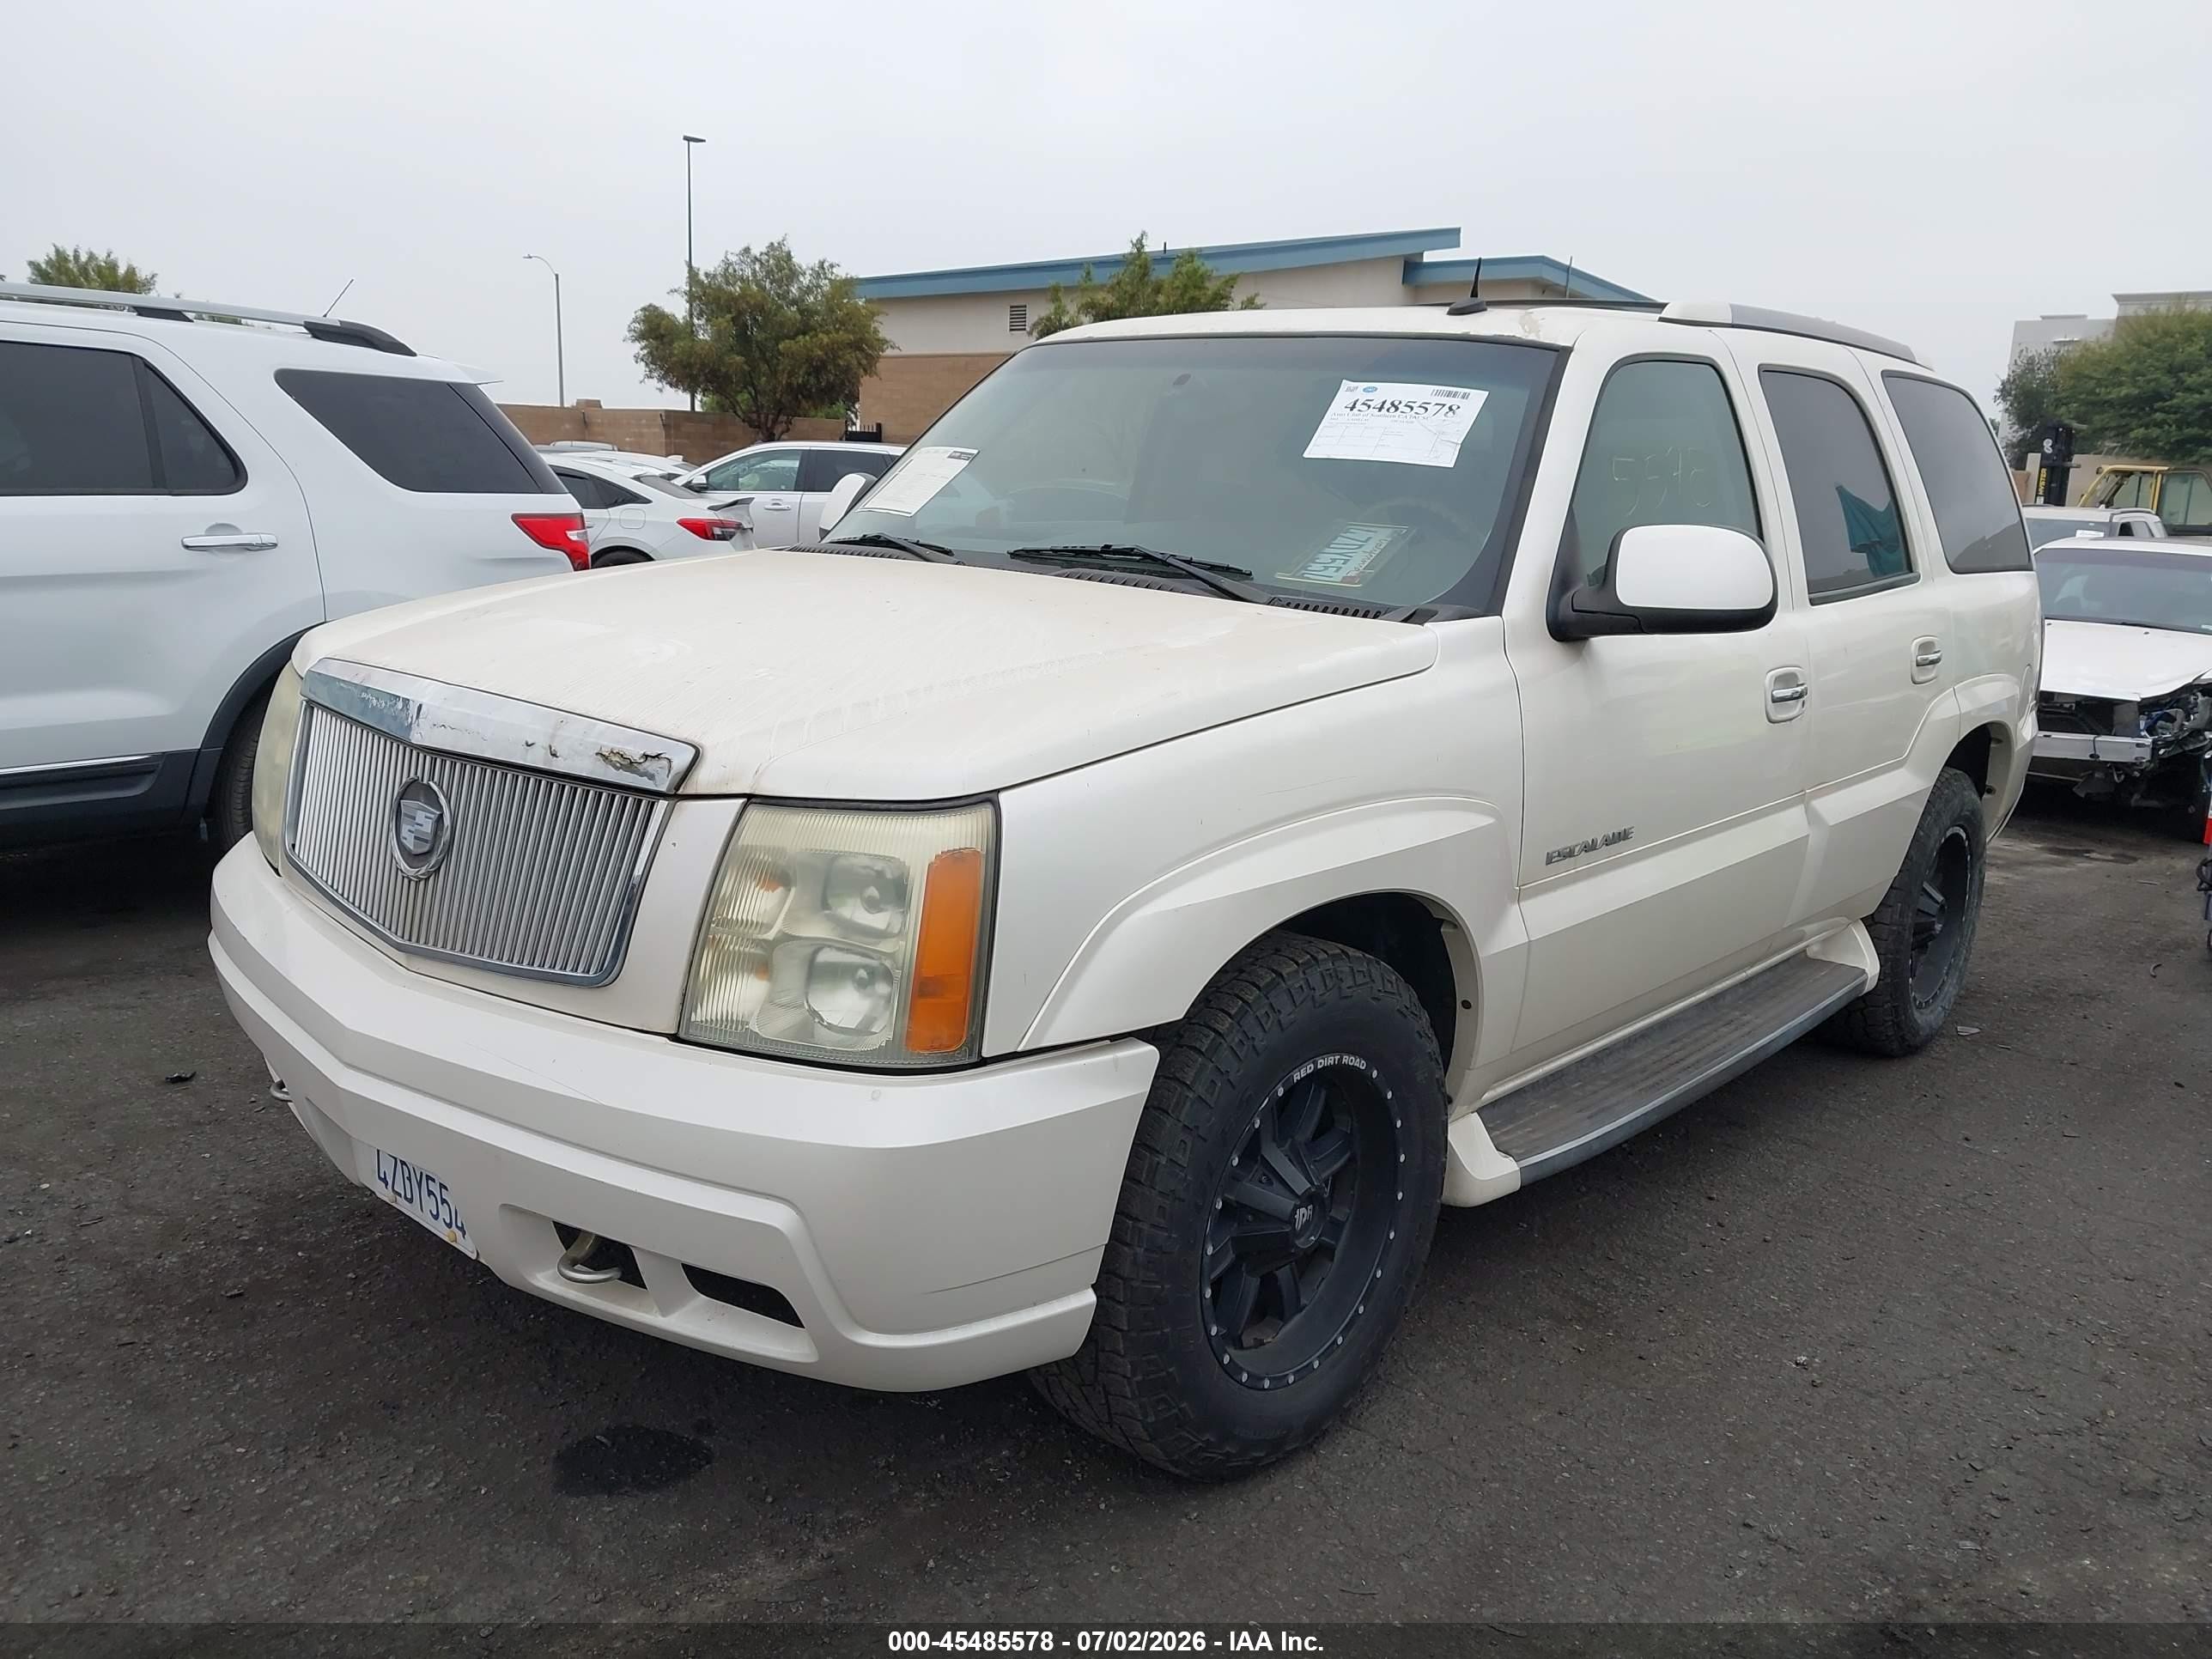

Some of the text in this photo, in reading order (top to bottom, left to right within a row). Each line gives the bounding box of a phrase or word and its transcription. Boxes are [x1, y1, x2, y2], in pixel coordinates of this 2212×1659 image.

[1344, 398, 1461, 418] 45485578
[1545, 825, 1635, 866] ESCALADE
[1293, 1055, 1367, 1083] RED DIRT ROAD
[376, 1148, 467, 1240] 4ZBY554
